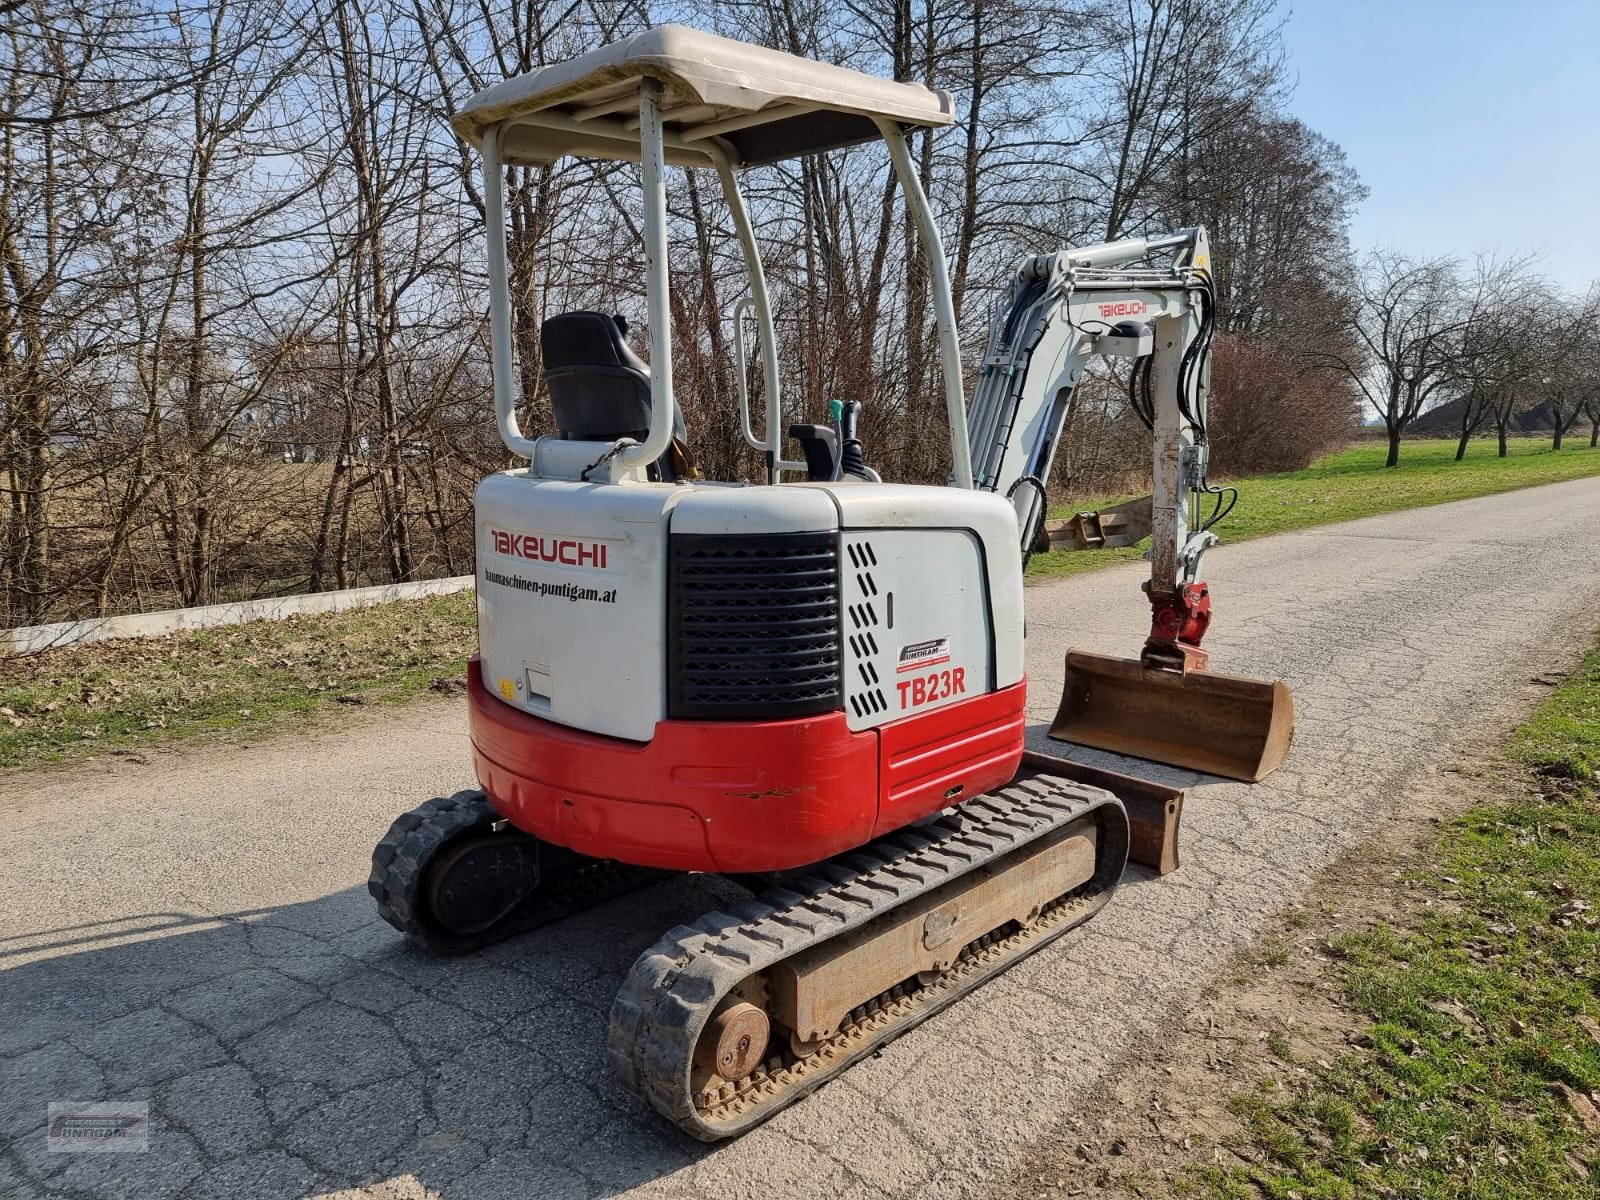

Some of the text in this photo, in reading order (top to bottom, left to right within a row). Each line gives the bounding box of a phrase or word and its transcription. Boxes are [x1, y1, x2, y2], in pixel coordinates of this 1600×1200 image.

[491, 529, 607, 569] TAKEUCHI
[485, 567, 617, 603] baumaschinen-puntigam.at
[896, 667, 966, 710] TB23R
